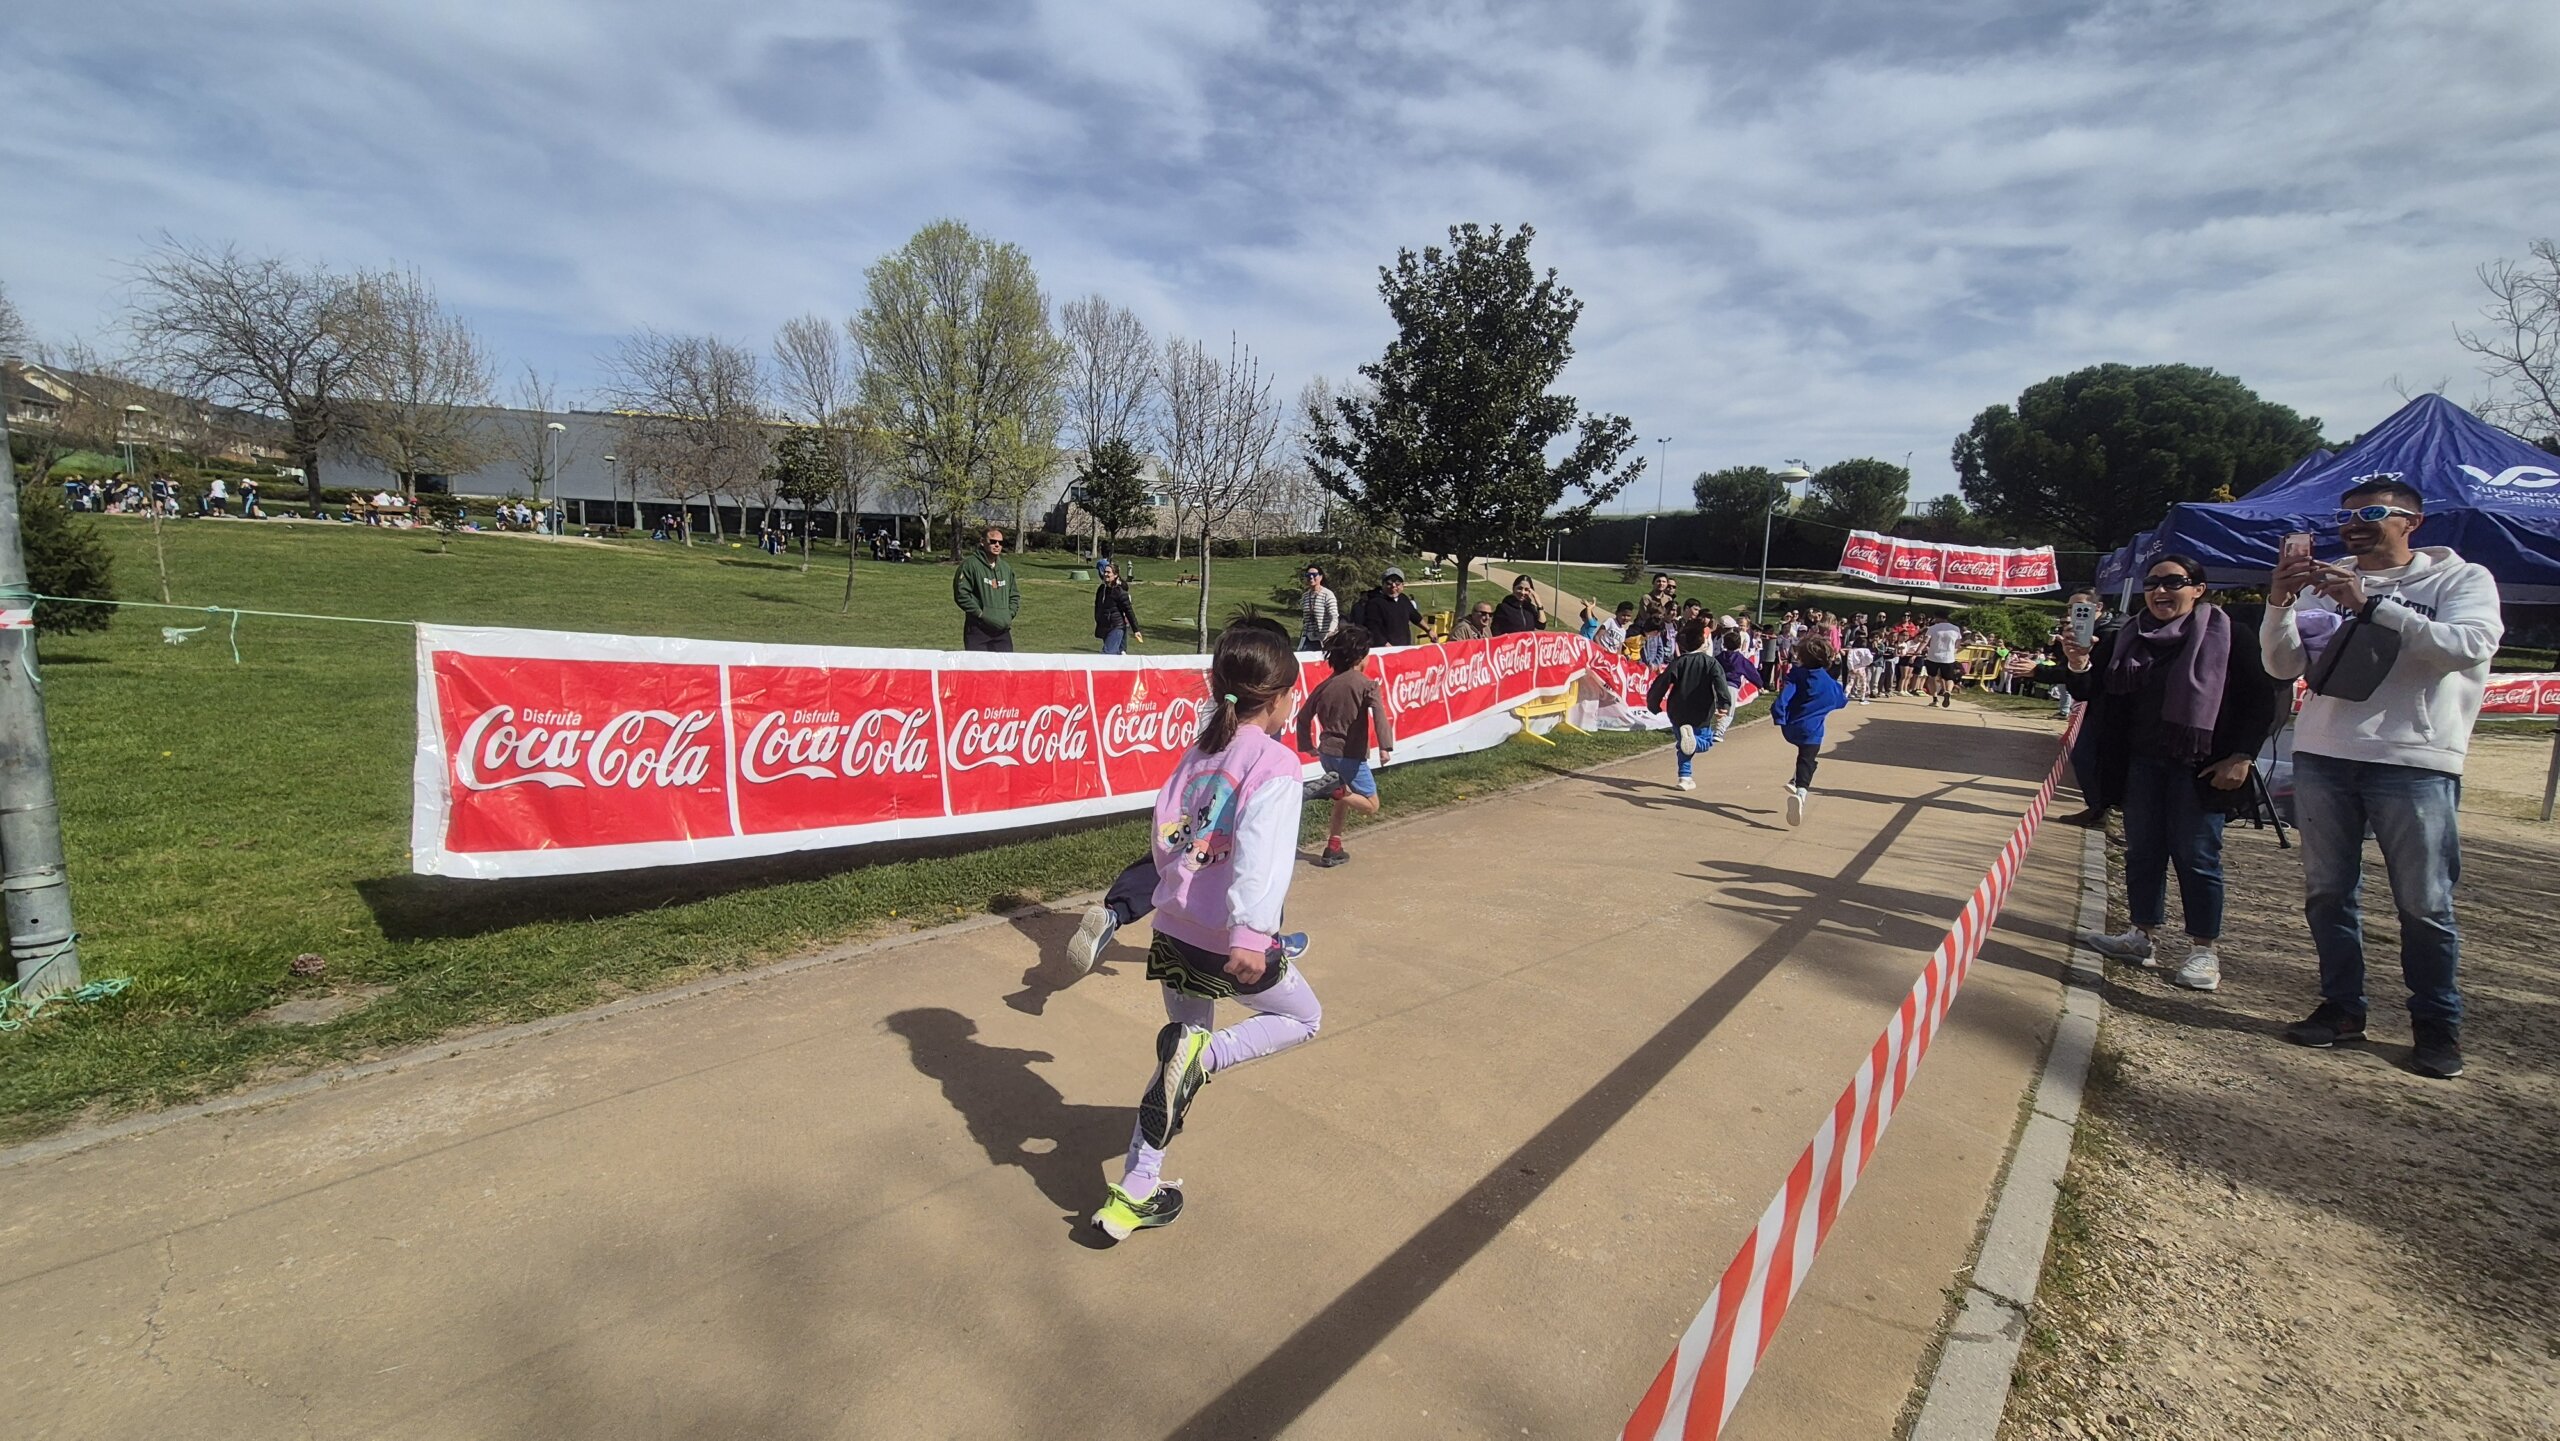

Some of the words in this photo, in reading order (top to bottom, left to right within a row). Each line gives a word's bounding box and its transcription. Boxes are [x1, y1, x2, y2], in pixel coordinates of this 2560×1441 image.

[1894, 555, 1939, 572] Coca-Cola
[1948, 560, 1999, 576] Coca-Cola
[2005, 562, 2049, 579] Coca-Cola
[1954, 584, 1988, 592] SALIDA
[984, 707, 1020, 720] Disfruta
[1126, 701, 1157, 713] Disfruta
[522, 708, 582, 726] Disfruta
[793, 709, 840, 724] Disfruta
[1102, 697, 1207, 758] Coca-Col
[740, 707, 932, 783] Coca-Cola
[947, 703, 1090, 771] Coca-Cola
[456, 704, 716, 790] Coca-Cola
